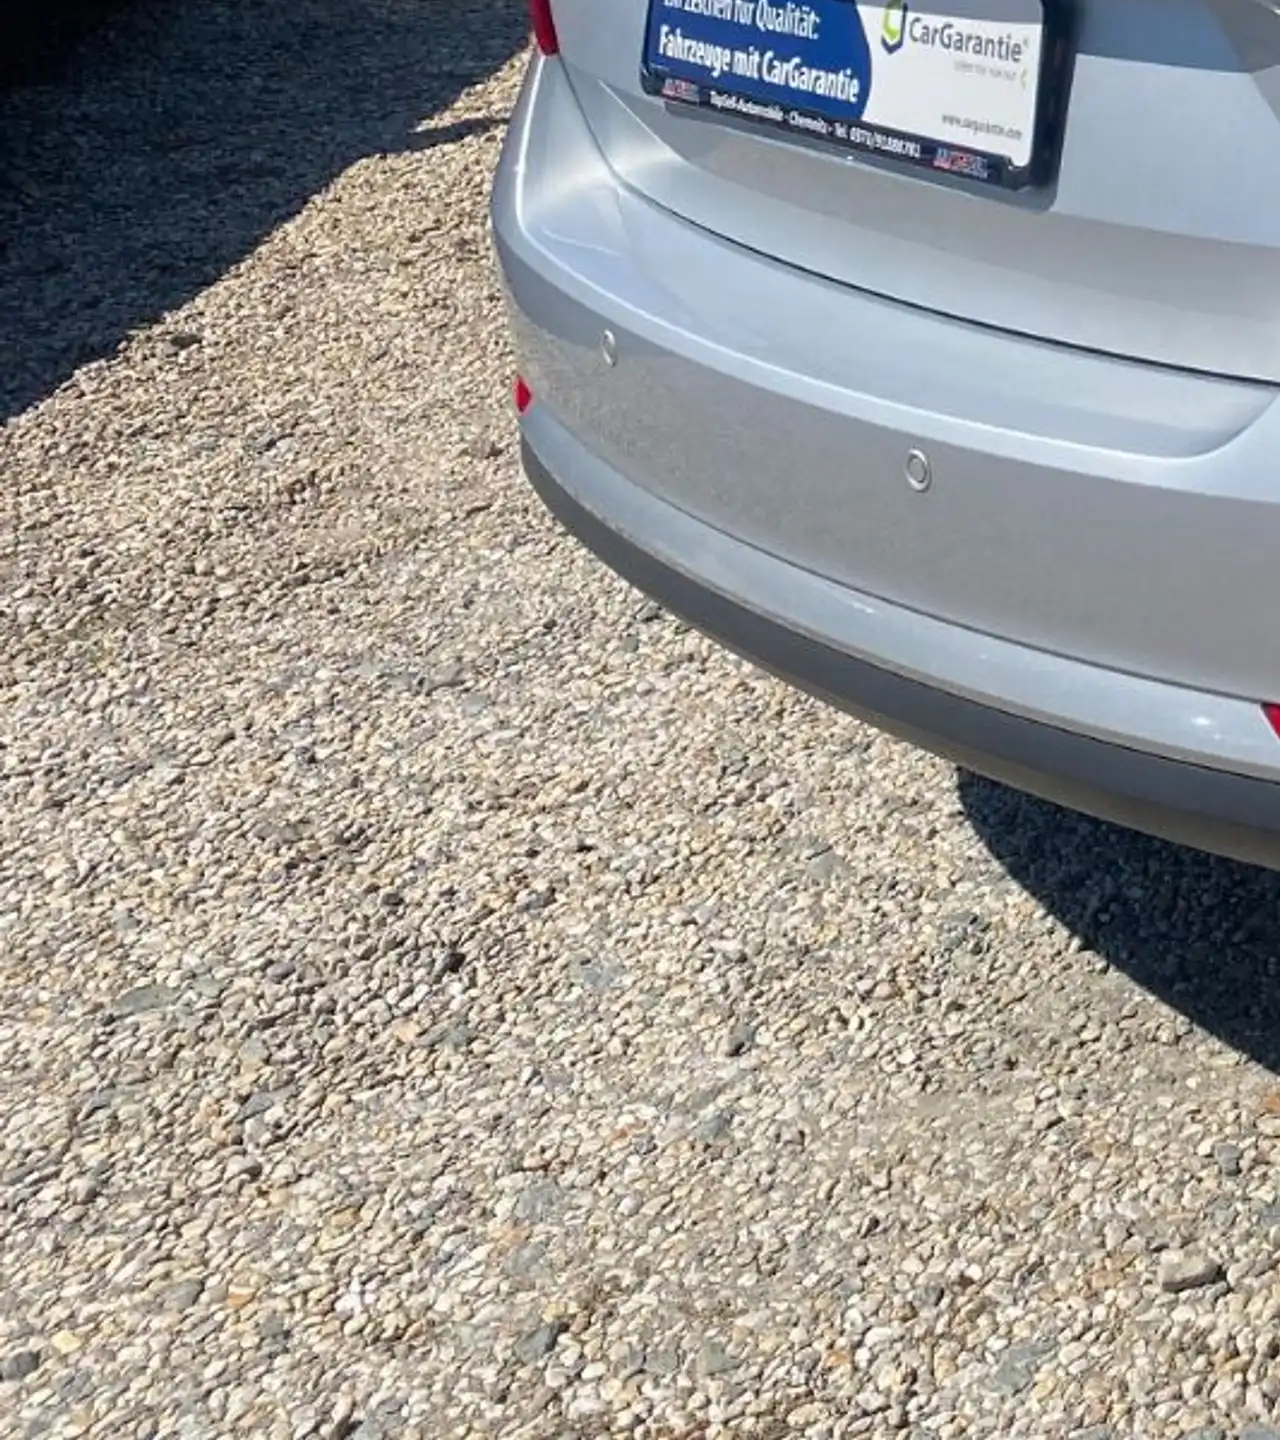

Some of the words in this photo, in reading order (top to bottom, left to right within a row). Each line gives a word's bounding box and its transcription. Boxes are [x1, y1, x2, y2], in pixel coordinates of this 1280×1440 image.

[659, 25, 731, 78] Fahrzeuge
[732, 46, 760, 80] mit
[762, 51, 860, 103] CarGarantie
[909, 17, 1024, 63] CarGarantie
